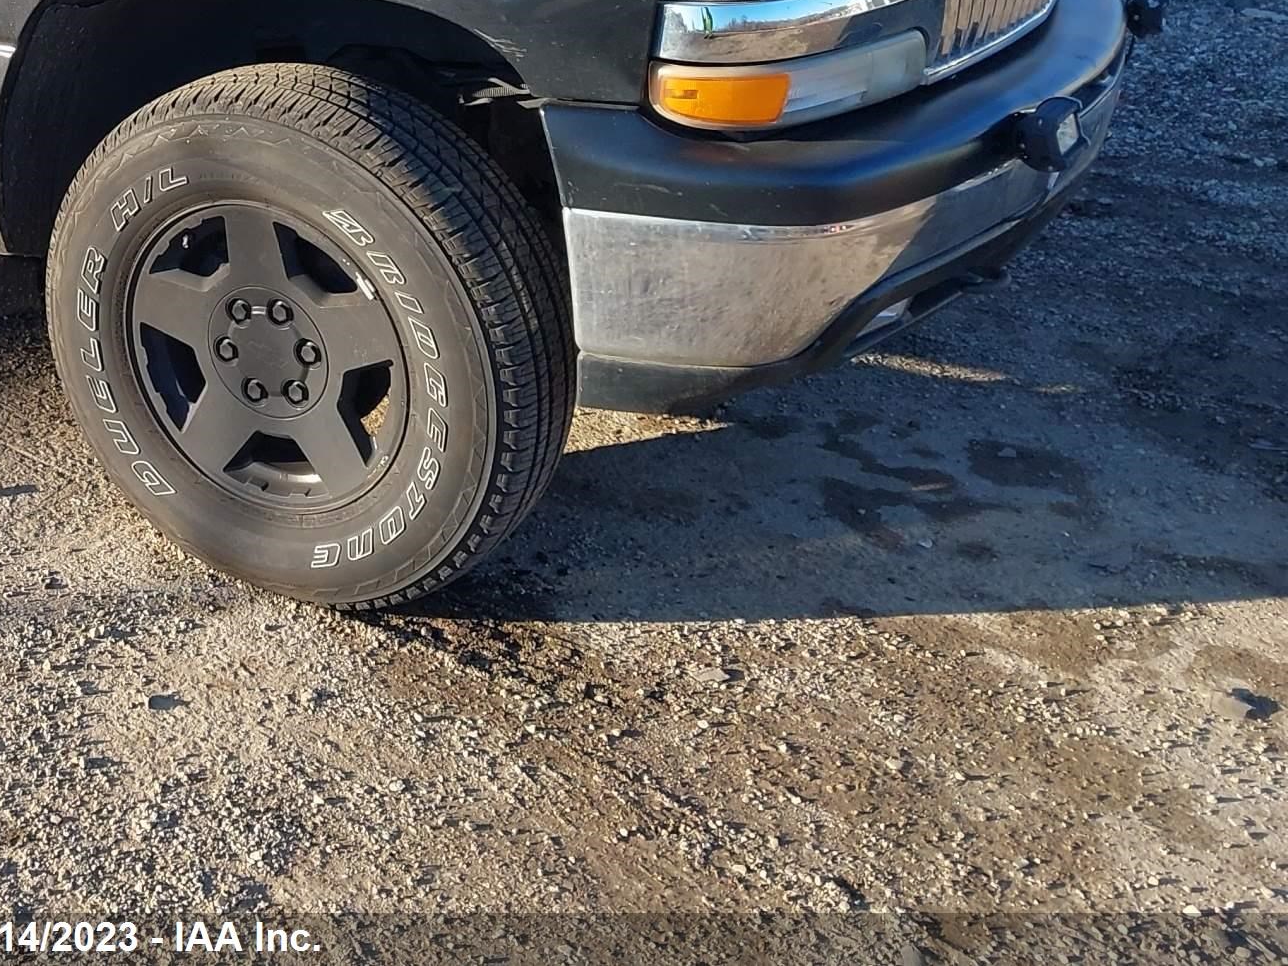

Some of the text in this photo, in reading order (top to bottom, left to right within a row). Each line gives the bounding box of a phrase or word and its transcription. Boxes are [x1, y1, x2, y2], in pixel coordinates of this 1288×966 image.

[77, 165, 191, 498] DUELER H/L
[311, 208, 451, 570] BRIDGESTONE
